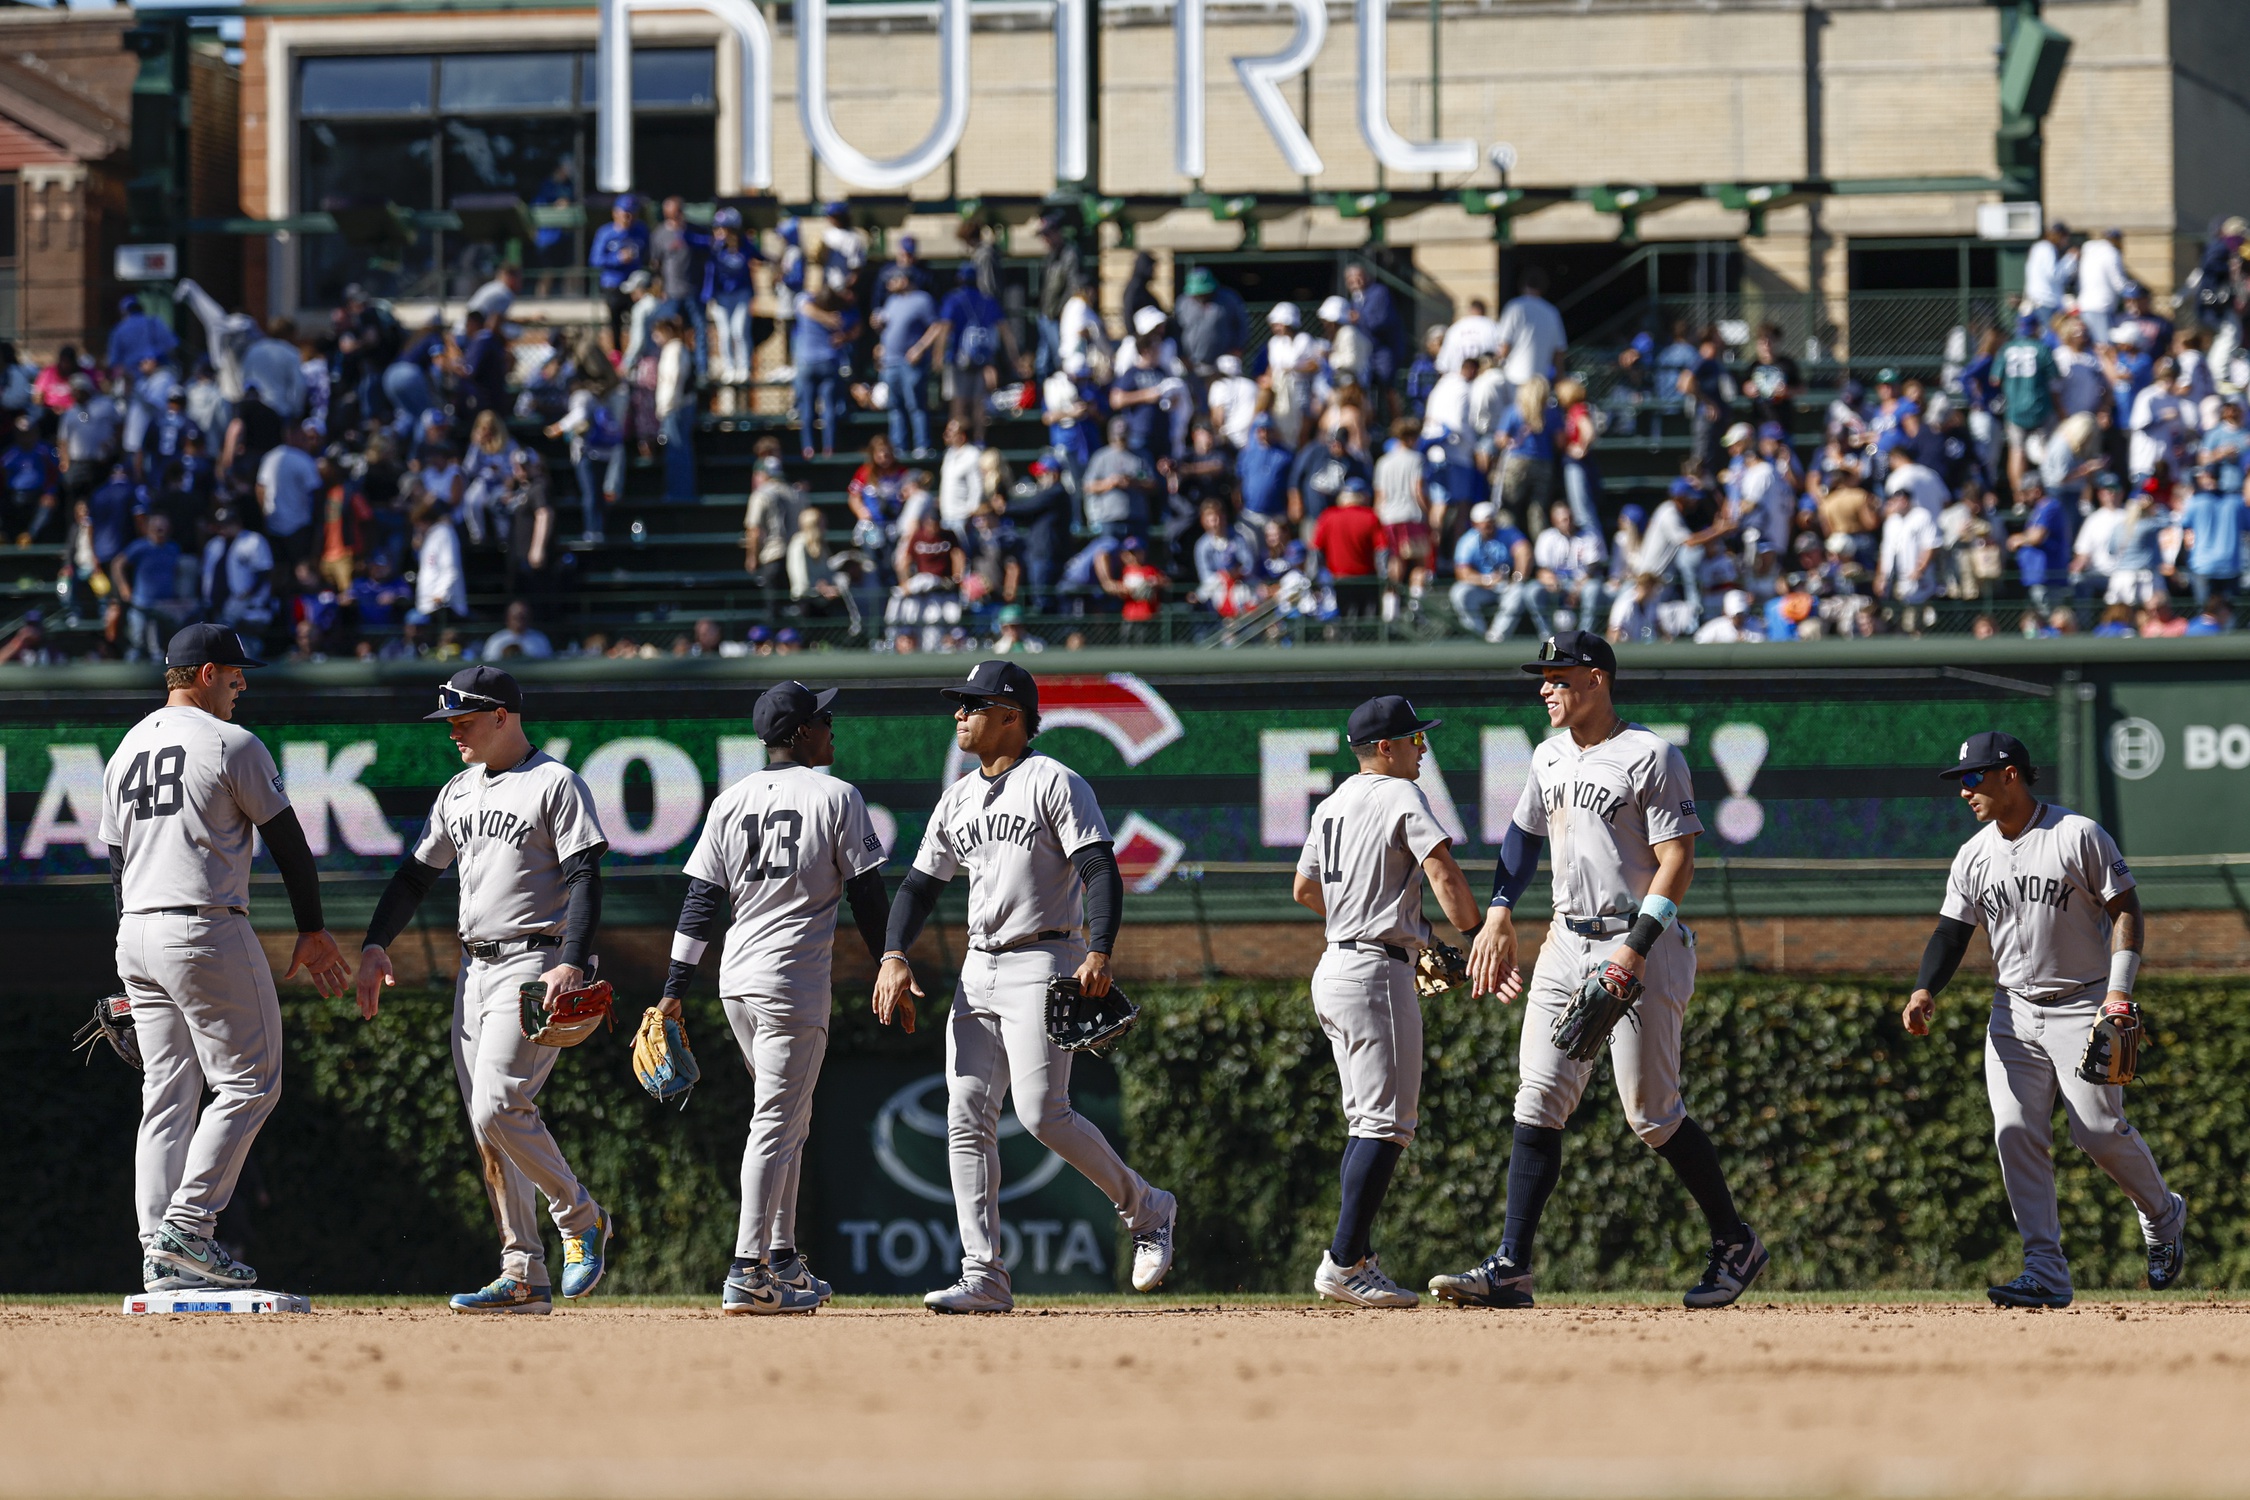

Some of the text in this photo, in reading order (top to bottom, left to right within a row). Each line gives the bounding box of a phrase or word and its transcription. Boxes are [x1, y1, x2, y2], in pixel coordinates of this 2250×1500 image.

[120, 744, 187, 821] 48
[1572, 780, 1629, 825] YORK
[450, 809, 535, 851] EW YORK
[741, 809, 803, 882] 13
[985, 812, 1042, 852] YORK
[1322, 816, 1345, 885] 11
[2013, 874, 2076, 912] YORK
